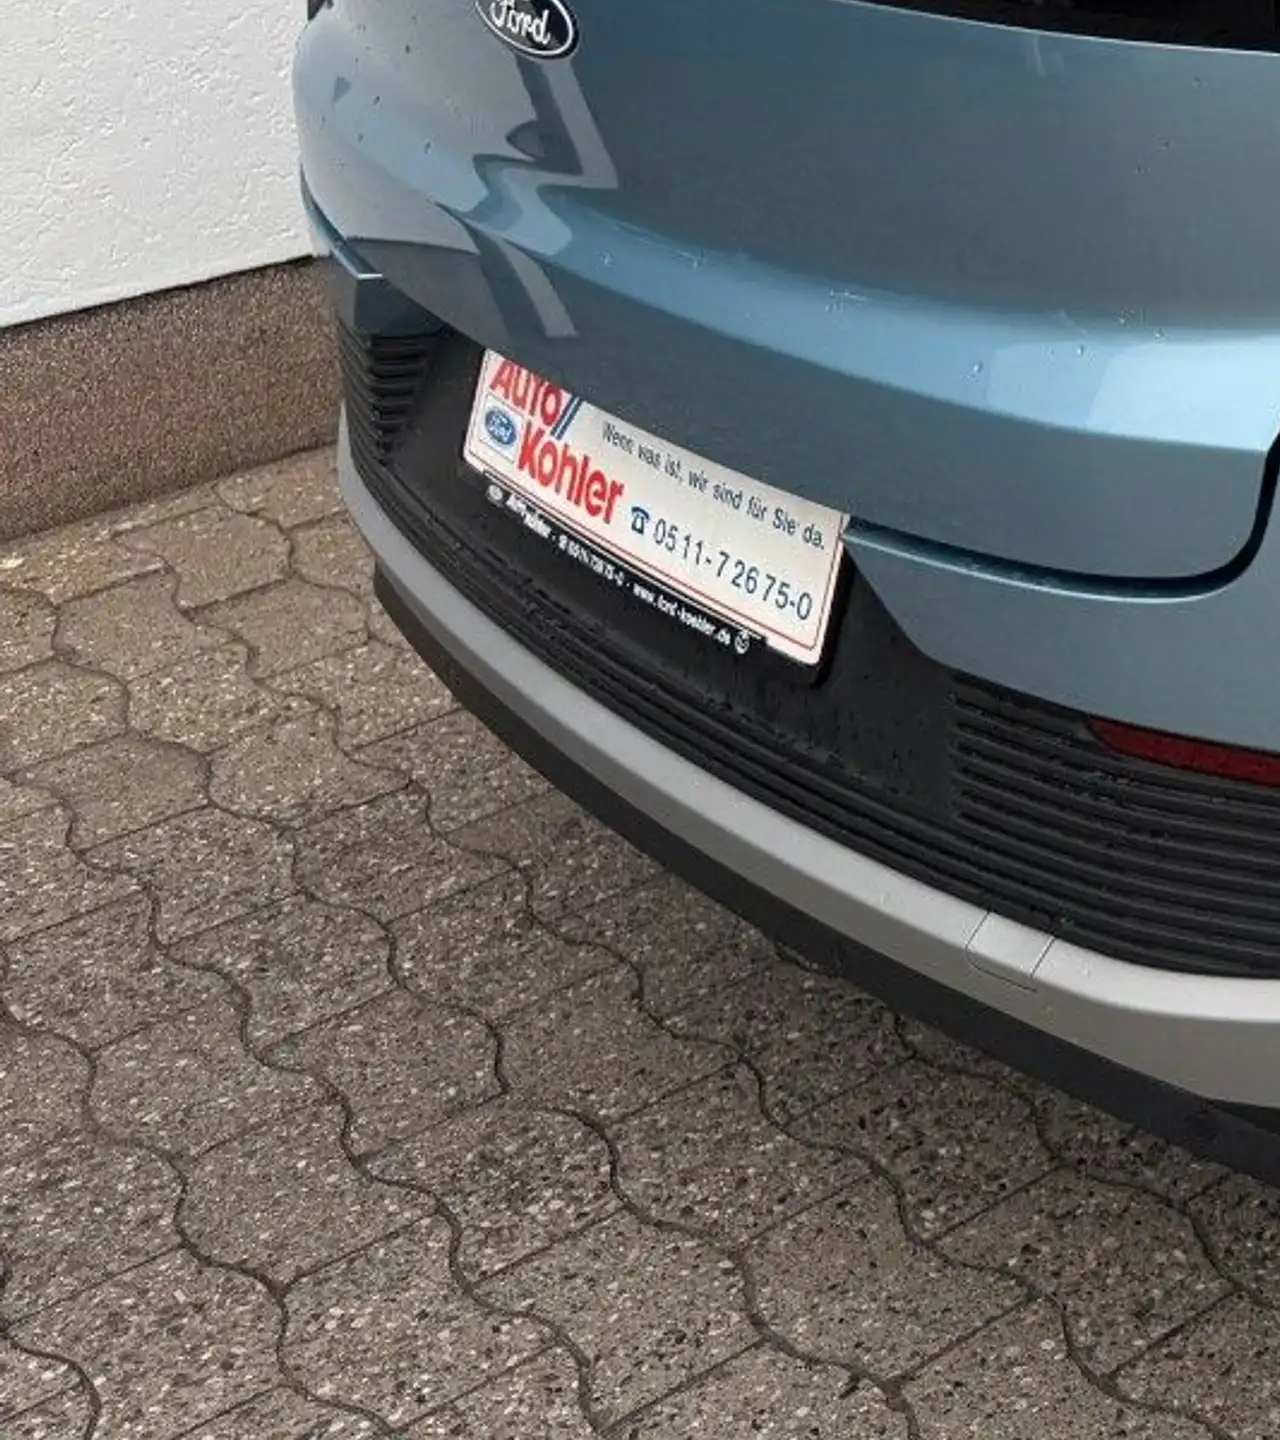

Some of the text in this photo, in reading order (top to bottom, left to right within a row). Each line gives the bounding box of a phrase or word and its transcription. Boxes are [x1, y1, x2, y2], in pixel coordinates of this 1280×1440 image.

[688, 470, 708, 493] wir
[713, 481, 743, 511] sind
[747, 495, 768, 521] für
